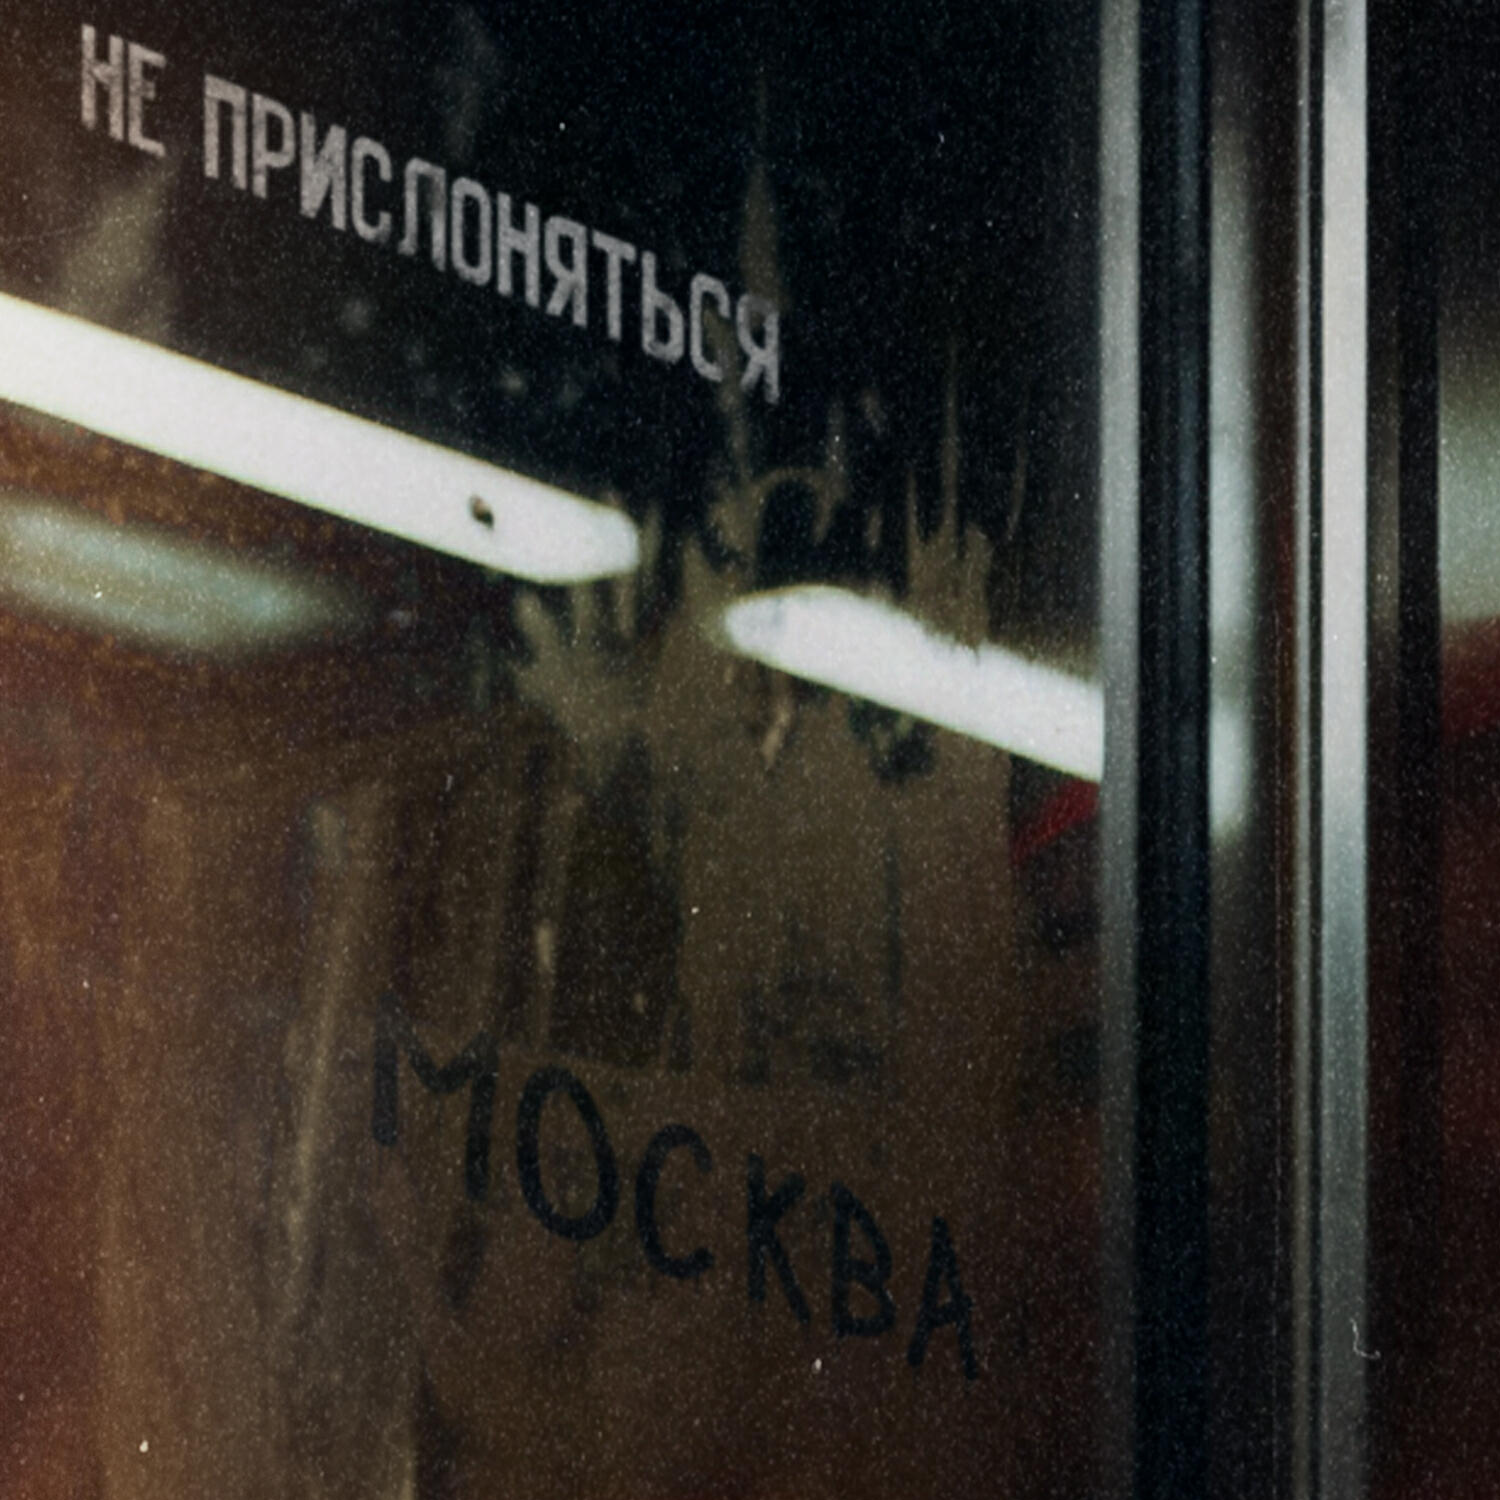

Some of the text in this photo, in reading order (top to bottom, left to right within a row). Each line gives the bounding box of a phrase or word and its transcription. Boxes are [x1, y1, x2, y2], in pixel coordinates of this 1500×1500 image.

[80, 23, 781, 403] НЕ ПРИСЛОНЯТЬСЯ
[370, 994, 979, 1381] МОСКВА
